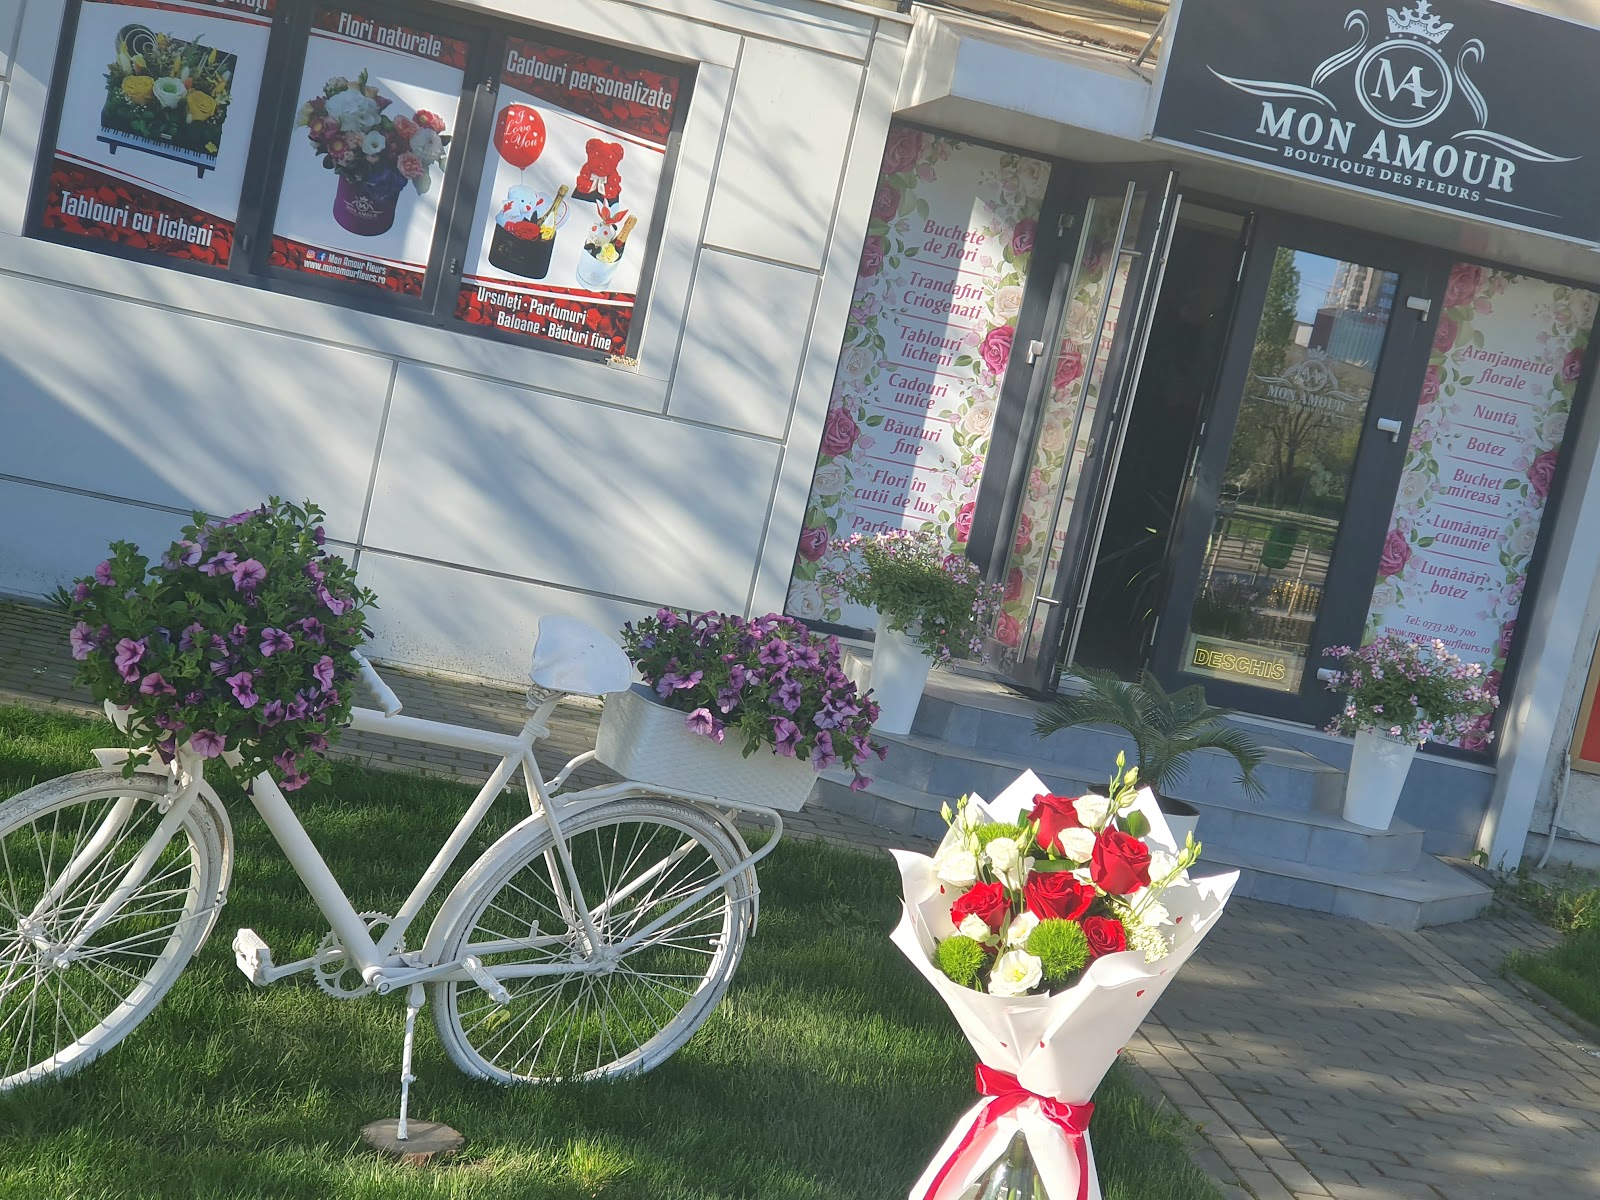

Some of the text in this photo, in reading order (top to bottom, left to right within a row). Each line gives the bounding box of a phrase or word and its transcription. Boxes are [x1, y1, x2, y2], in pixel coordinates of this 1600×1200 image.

[338, 11, 442, 57] Flori naturale
[506, 49, 672, 110] Cadouri personalizate
[504, 119, 531, 135] Love
[510, 131, 537, 149] You
[1255, 101, 1516, 193] MON AMOUR
[1282, 144, 1480, 202] BOUTIQUE DES FLEURS
[60, 190, 214, 247] Tablouri cu licheni
[923, 219, 985, 246] Buchete
[328, 253, 342, 265] Mon
[343, 256, 366, 270] Amour
[923, 238, 979, 262] de flori
[909, 271, 985, 301] Trandafiri
[477, 286, 588, 325] Ursuleți Parfumuri
[903, 290, 983, 321] Criogenați
[497, 311, 612, 350] Baloane Băuturi fine
[900, 325, 965, 352] Tablouri
[901, 343, 954, 367] licheni
[1462, 345, 1553, 376] Aranjamente
[888, 373, 949, 398] Cadouri
[1476, 368, 1526, 390] florale
[894, 391, 936, 410] unice
[1473, 404, 1518, 426] Nuntă
[883, 418, 943, 443] Băuturi
[890, 438, 924, 456] fine
[1467, 436, 1506, 457] Botez
[872, 469, 927, 493] Flori în
[1453, 468, 1502, 490] Buchet
[854, 487, 938, 514] cutii de lux
[1447, 485, 1501, 506] mireasă
[1432, 514, 1499, 540] Lumânări
[1434, 532, 1490, 552] cununie
[1420, 561, 1487, 586] Lumânări
[1430, 580, 1468, 600] botez
[1405, 615, 1476, 637] Tel: 0733 282 700
